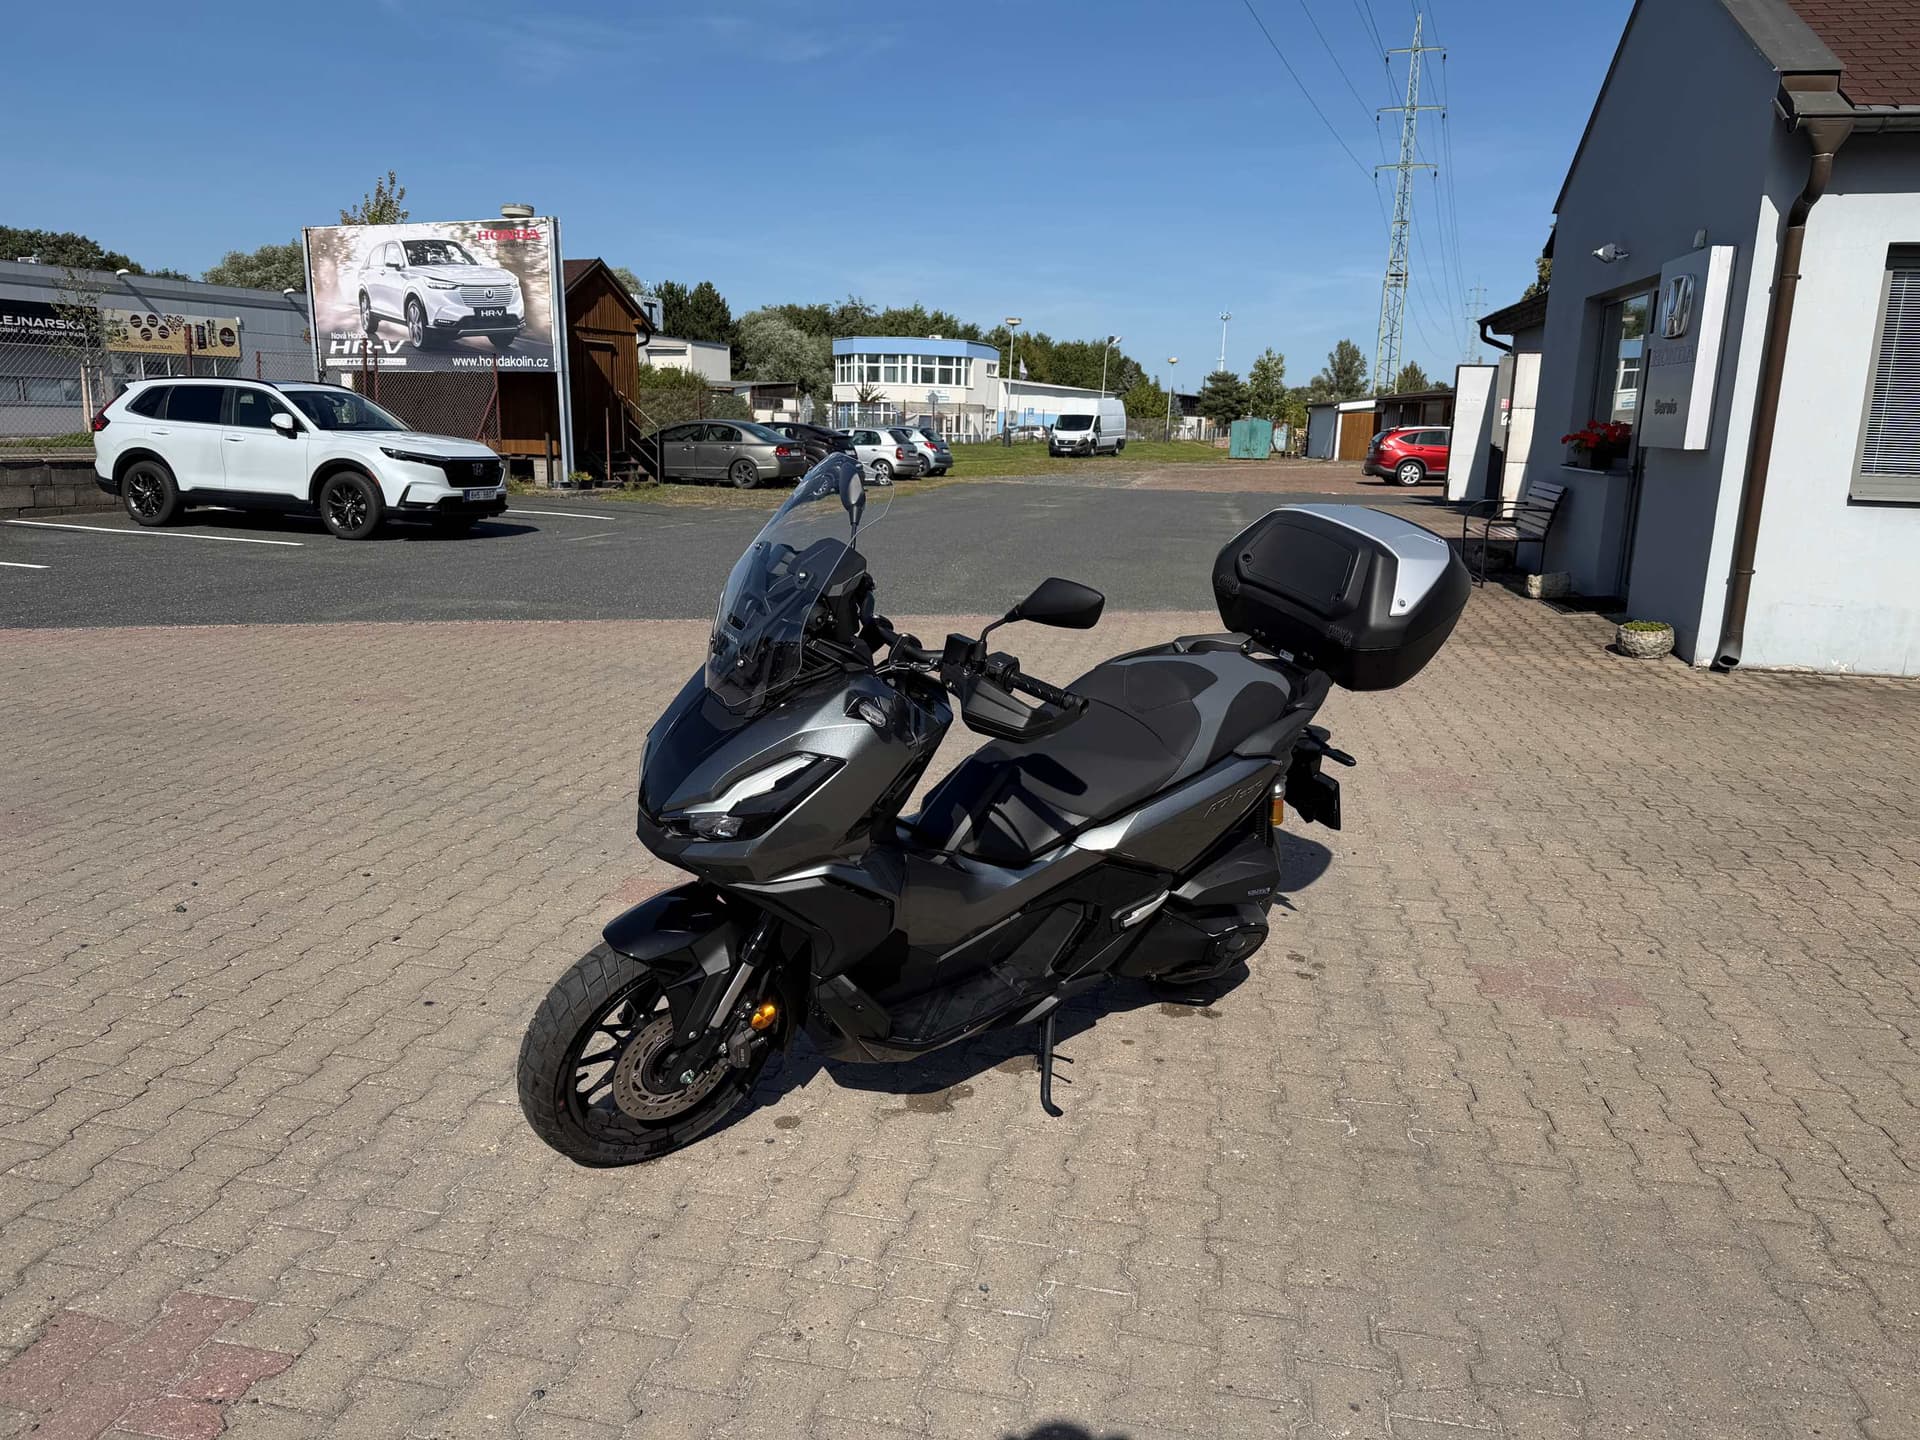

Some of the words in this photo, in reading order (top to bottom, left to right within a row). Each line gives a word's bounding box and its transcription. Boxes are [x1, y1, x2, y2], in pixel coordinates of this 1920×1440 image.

[477, 228, 541, 241] HONDA
[331, 331, 347, 339] Nová
[330, 340, 405, 354] HR-V
[1654, 398, 1678, 415] Servis
